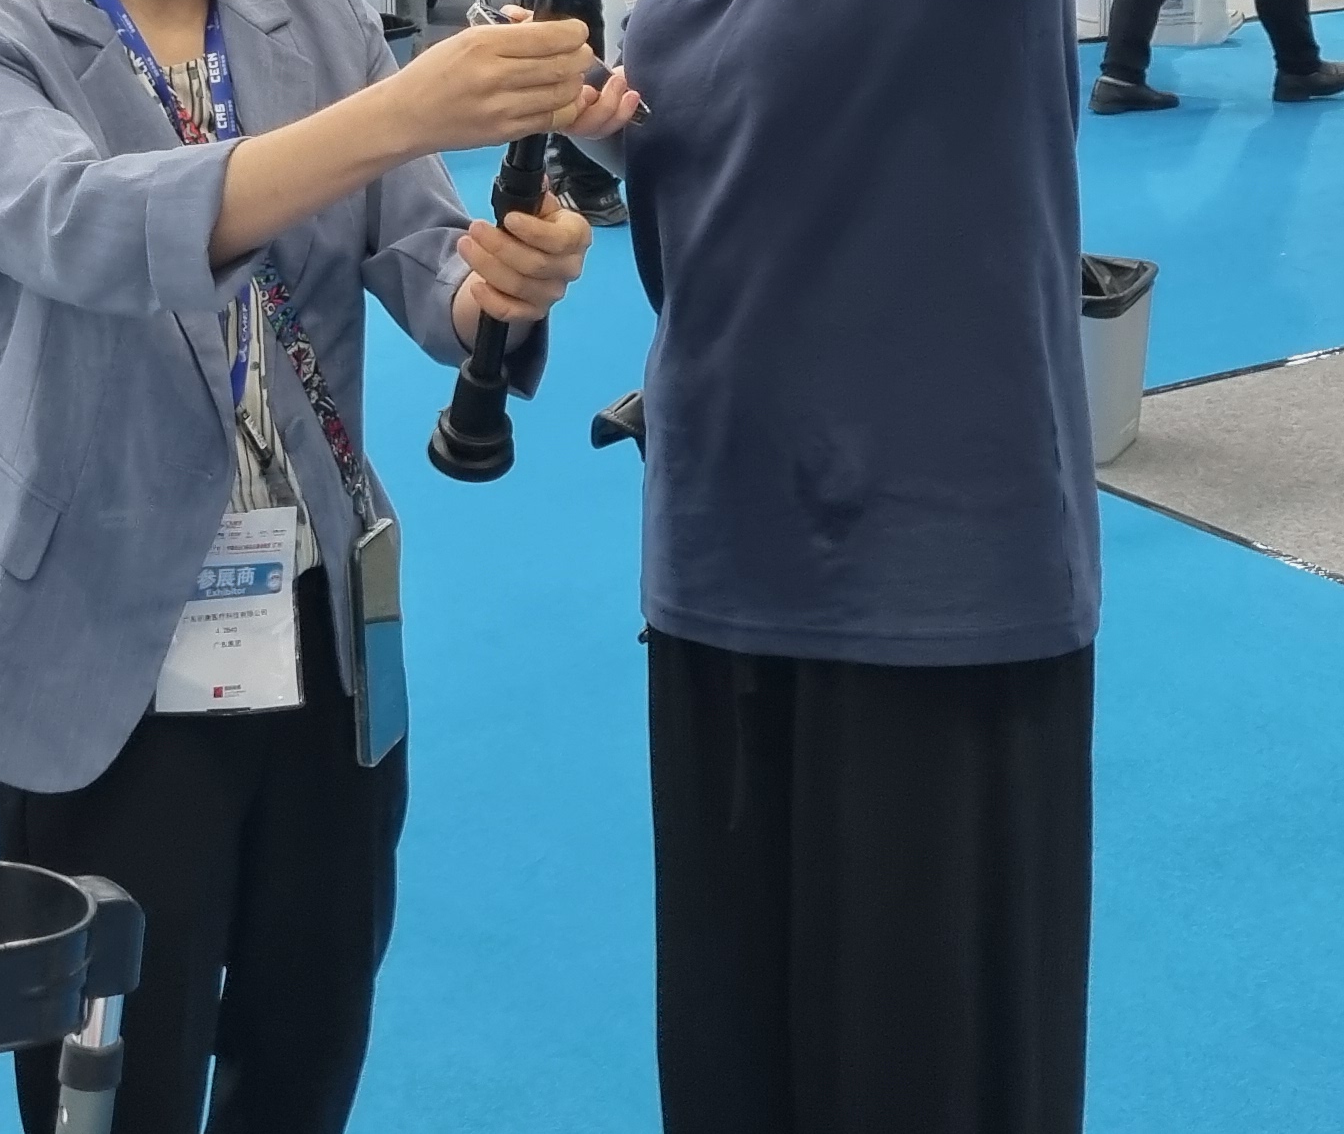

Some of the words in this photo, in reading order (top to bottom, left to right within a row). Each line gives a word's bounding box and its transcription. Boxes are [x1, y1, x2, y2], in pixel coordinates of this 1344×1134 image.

[207, 52, 221, 84] CECN
[197, 567, 256, 589] 参展商
[206, 587, 247, 596] Exhibitor
